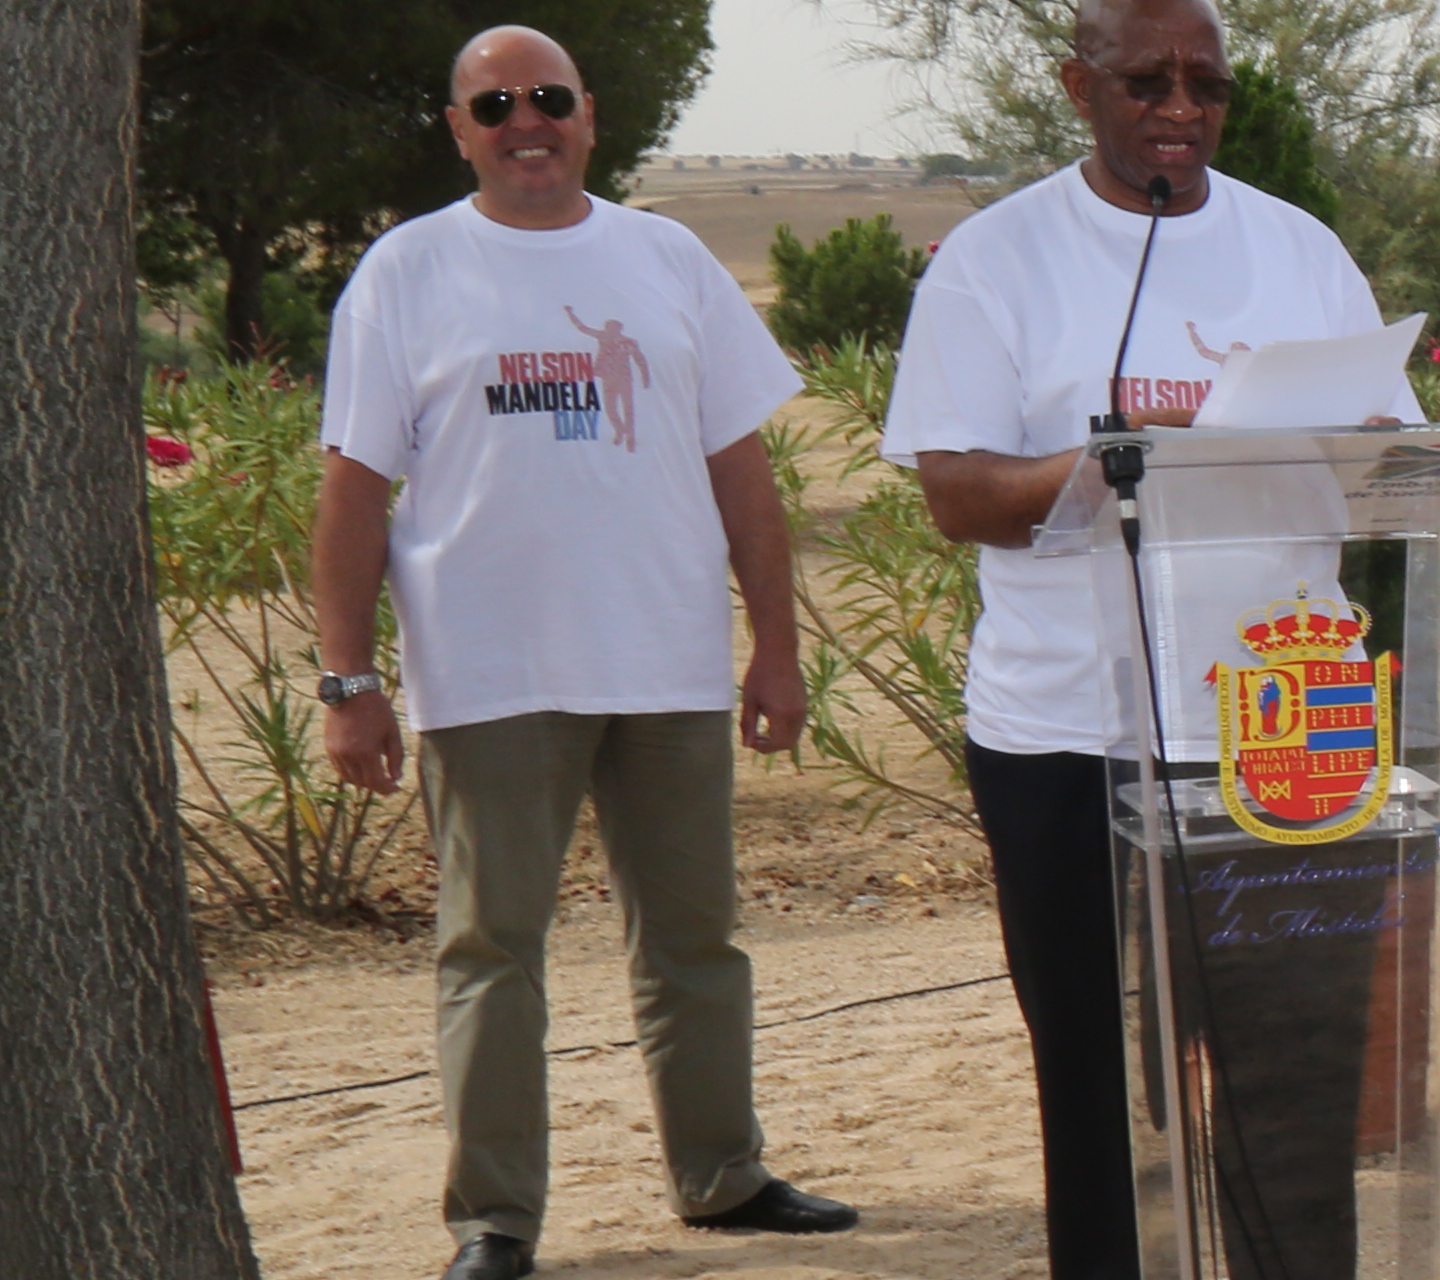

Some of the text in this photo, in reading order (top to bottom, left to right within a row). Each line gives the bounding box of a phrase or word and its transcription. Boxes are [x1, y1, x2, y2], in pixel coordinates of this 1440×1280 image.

[498, 352, 595, 384] NELSON
[484, 381, 601, 415] MANDELA
[554, 410, 600, 440] DAY
[1380, 725, 1391, 742] DE
[1312, 750, 1371, 773] LIPE
[1381, 748, 1391, 781] VILLA
[1375, 786, 1387, 805] LA
[1275, 820, 1360, 843] AYUNTAMIENTO
[1176, 851, 1439, 916] Ayuntamiento
[1207, 913, 1243, 945] de
